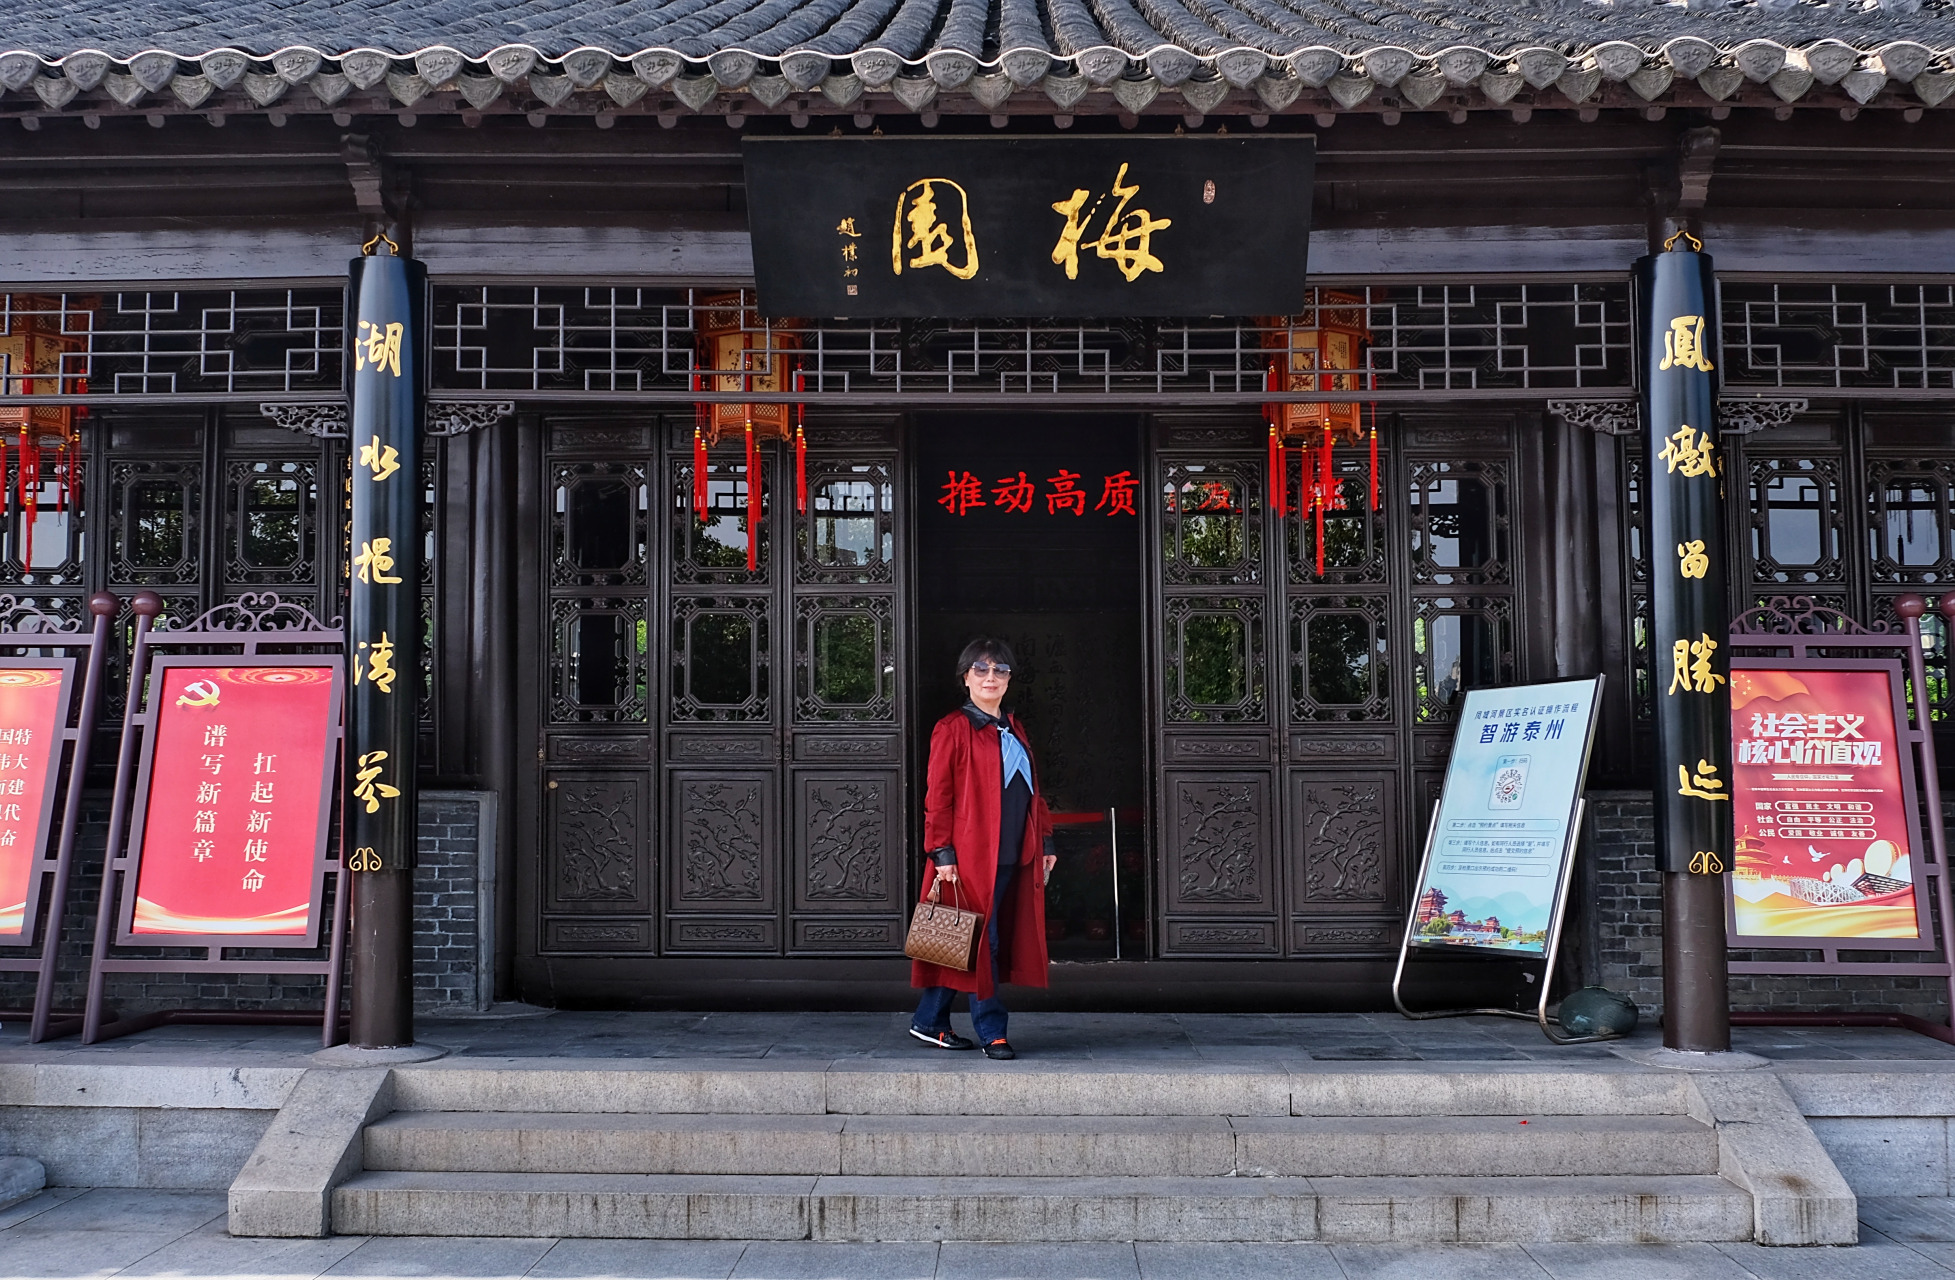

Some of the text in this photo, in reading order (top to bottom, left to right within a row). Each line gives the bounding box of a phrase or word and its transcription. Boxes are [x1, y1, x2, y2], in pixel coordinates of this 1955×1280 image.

[937, 469, 1140, 517] 推动高质
[1479, 718, 1565, 744] 智游泰州
[1751, 713, 1865, 739] 社会主义
[1738, 739, 1882, 766] 核心价值观
[190, 724, 228, 863] 谱写新篇章
[1755, 802, 1772, 810] 国家
[241, 752, 277, 893] 扛起新使命
[1757, 815, 1774, 823] 社会
[1758, 829, 1775, 837] 公民
